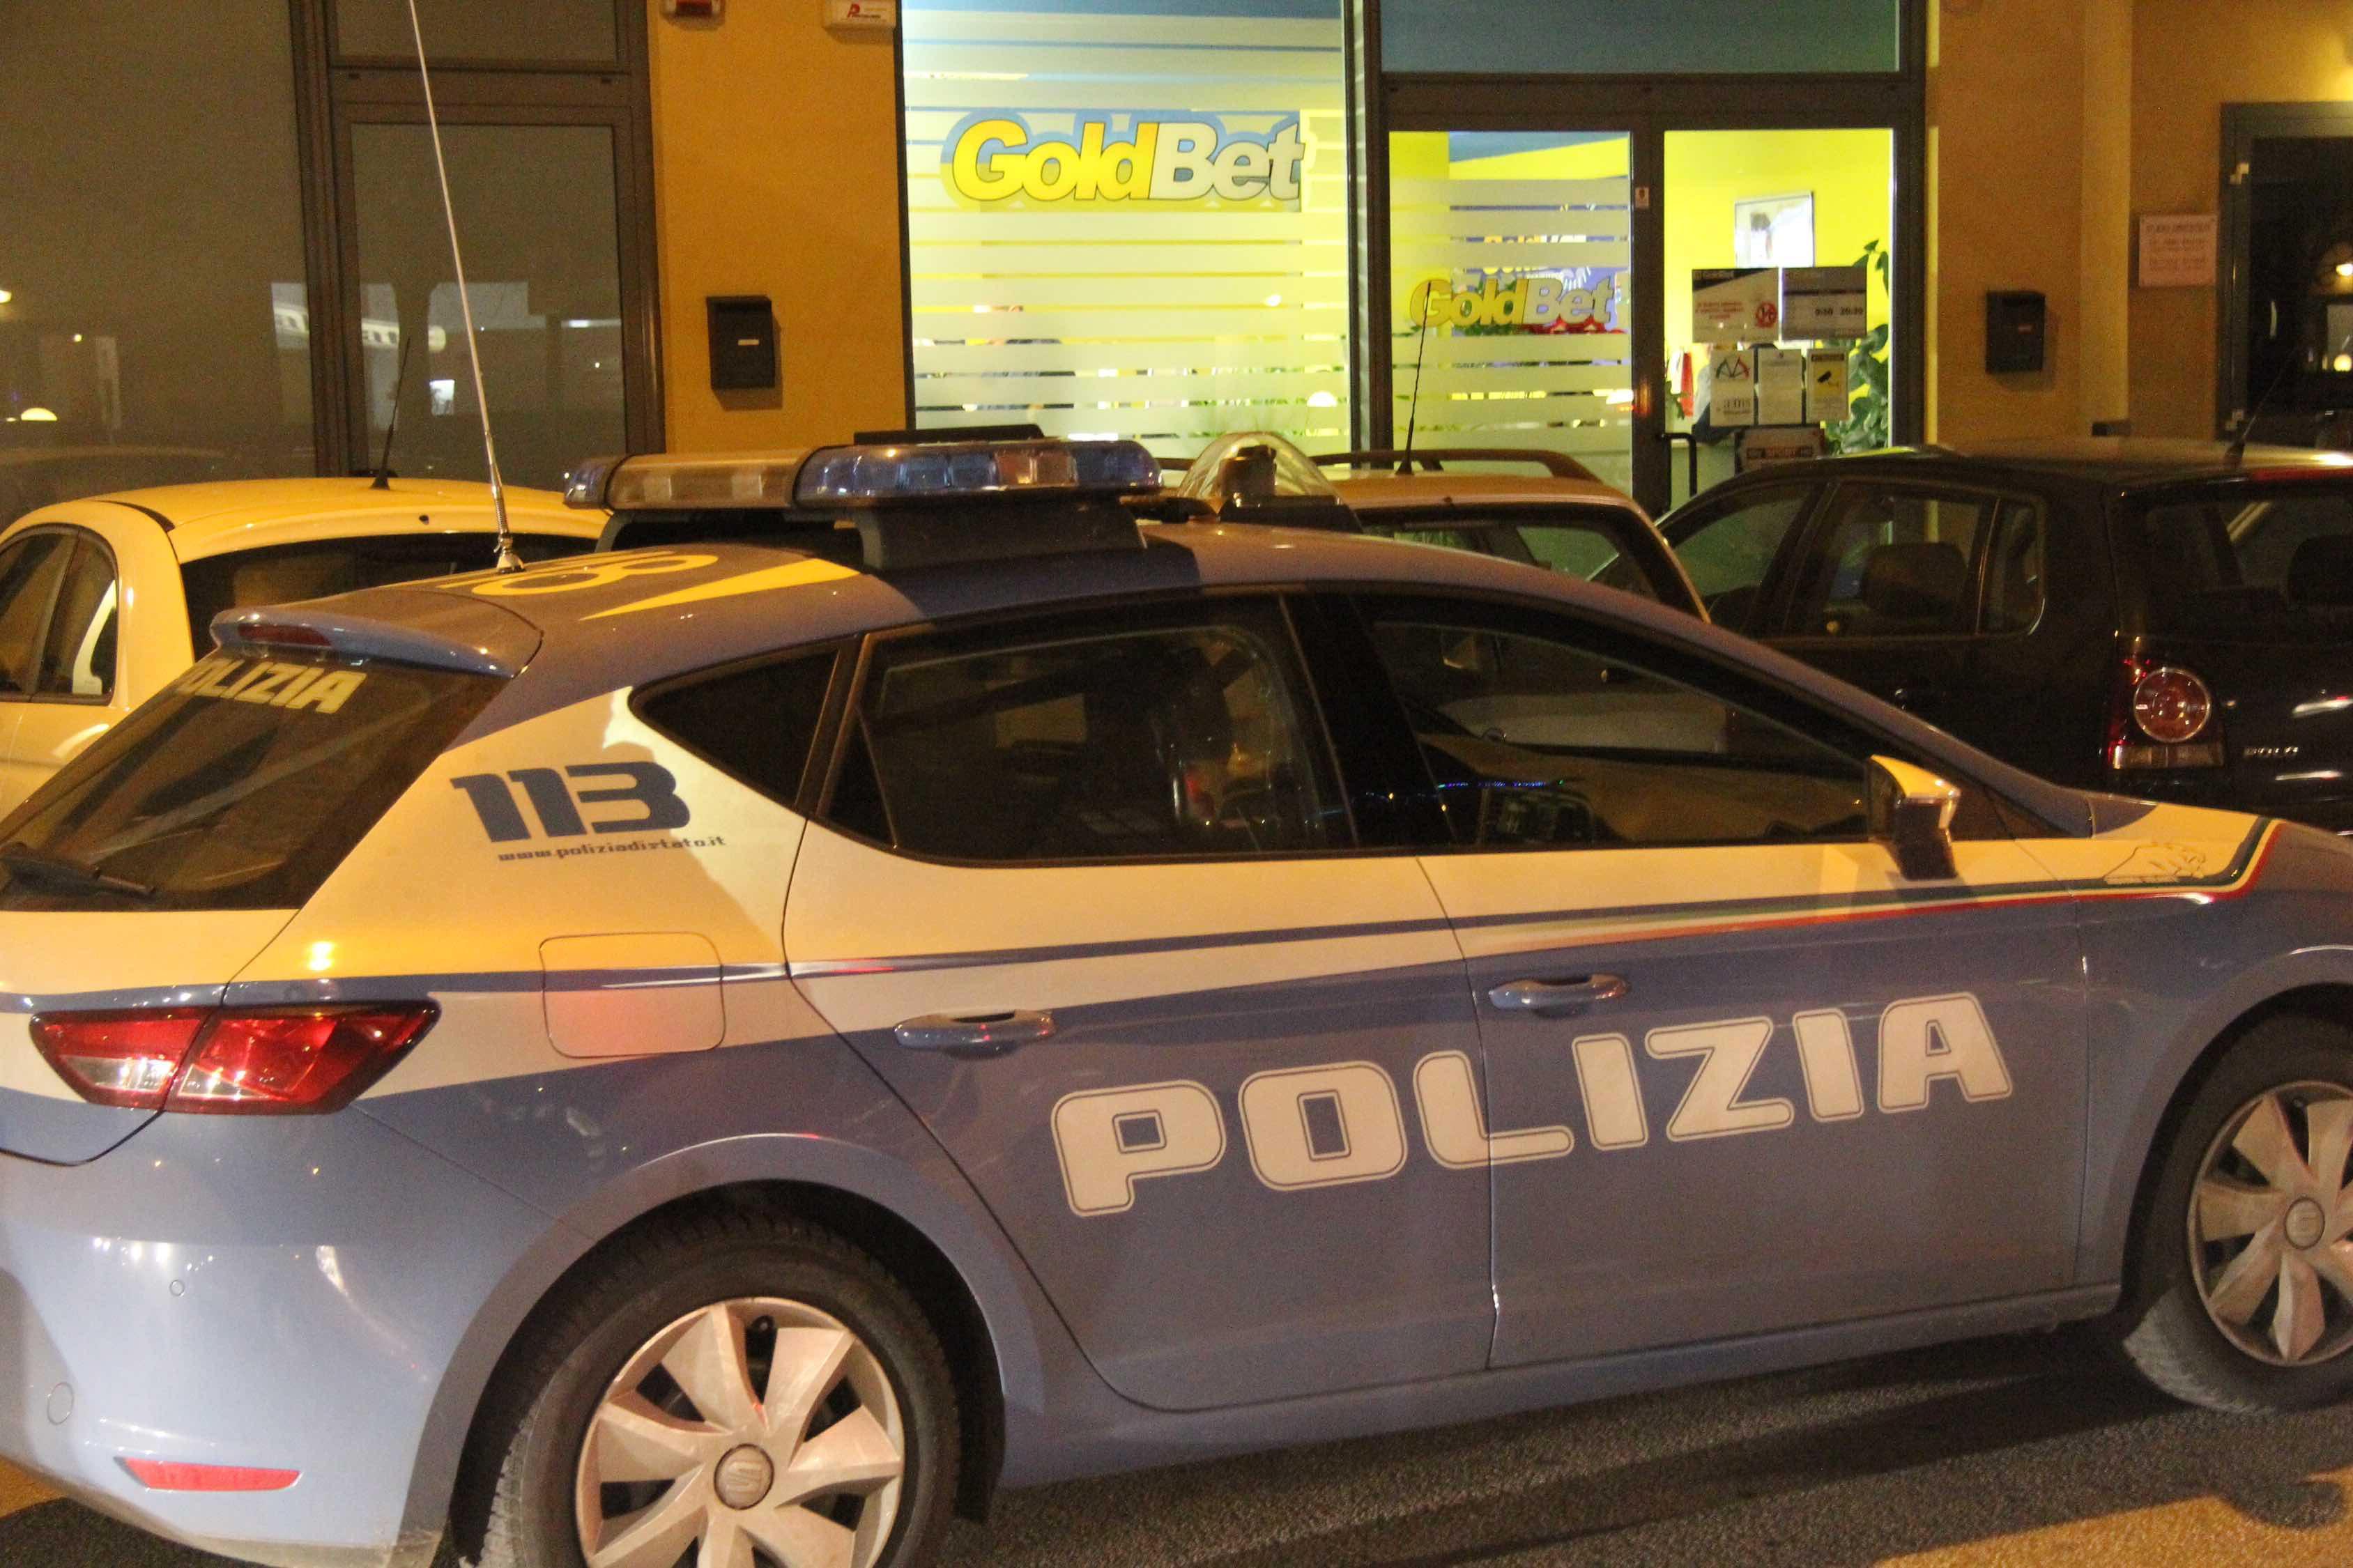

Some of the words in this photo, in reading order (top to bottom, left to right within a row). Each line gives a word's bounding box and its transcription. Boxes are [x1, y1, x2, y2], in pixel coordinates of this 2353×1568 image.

[952, 119, 1305, 201] GoldBet
[1409, 277, 1614, 328] GoldBet
[450, 761, 691, 842] 113
[1051, 992, 2012, 1217] POLIZIA
